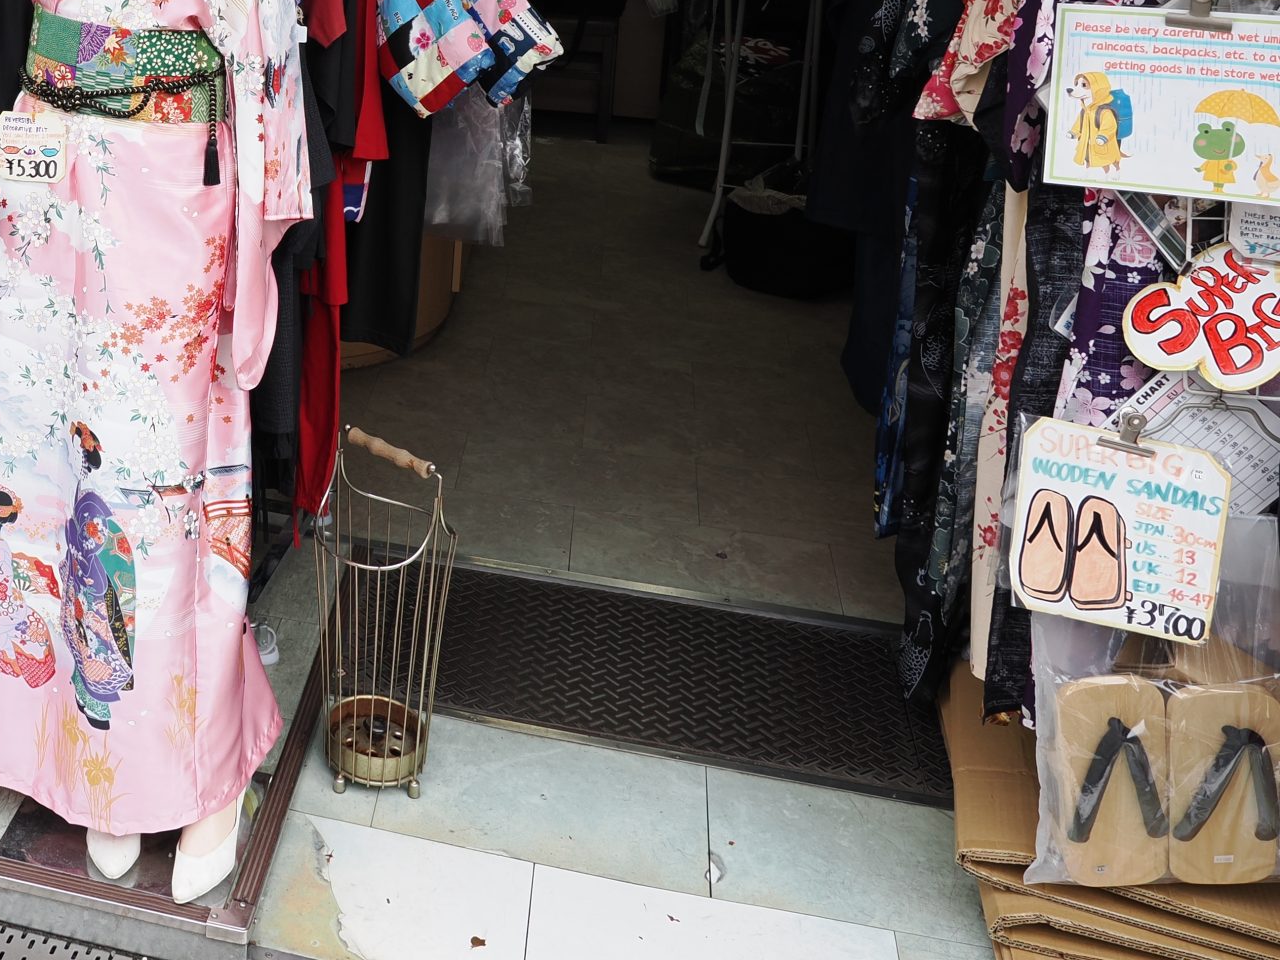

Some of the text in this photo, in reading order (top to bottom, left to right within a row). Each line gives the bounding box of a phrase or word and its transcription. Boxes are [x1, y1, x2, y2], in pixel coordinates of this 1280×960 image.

[1075, 21, 1112, 33] Please
[1115, 24, 1130, 34] be
[1134, 26, 1159, 37] very
[1162, 27, 1204, 38] careful
[1209, 29, 1234, 40] with
[1237, 32, 1259, 42] wet
[1091, 42, 1266, 61] raincoats, backpacks, etc. to
[1104, 60, 1280, 81] getting goods in the store wet
[1244, 211, 1265, 220] THESE
[1240, 219, 1269, 227] FAMOUS
[1131, 248, 1270, 356] SUPER
[1136, 373, 1171, 406] CHART
[1167, 390, 1178, 400] EU
[1173, 395, 1187, 407] 34.5
[1189, 408, 1203, 420] 35.5
[1199, 416, 1208, 424] 36
[1204, 420, 1218, 432] 36.5
[1220, 433, 1233, 445] 37.5
[1230, 441, 1239, 450] 38
[1040, 426, 1184, 481] SUPER BIG
[1235, 445, 1249, 458] 38.5
[1245, 454, 1254, 462] 39
[1250, 458, 1265, 470] 39.5
[1261, 466, 1269, 475] 40
[1266, 471, 1279, 482] 40.5
[1032, 455, 1225, 516] WOODEN SANDALS
[1135, 502, 1174, 521] SIZE
[1133, 521, 1217, 550] JPN 30cm
[1136, 540, 1196, 565] US 13
[1132, 559, 1198, 586] UK 12
[1132, 579, 1214, 610] EU 46-47
[1125, 600, 1206, 640] ¥3700
